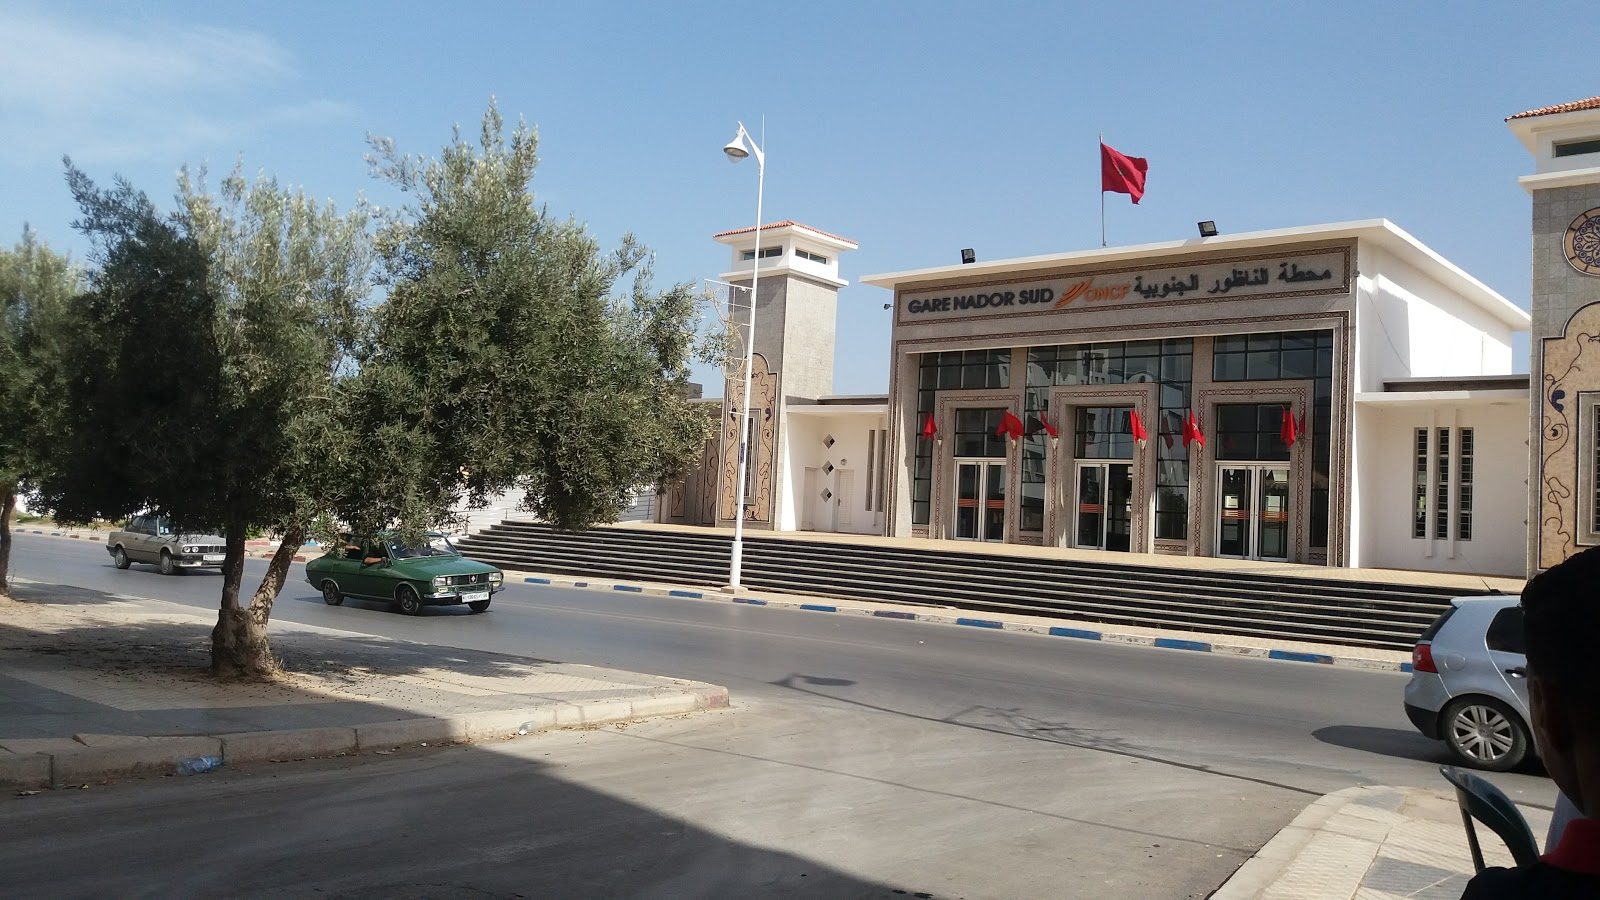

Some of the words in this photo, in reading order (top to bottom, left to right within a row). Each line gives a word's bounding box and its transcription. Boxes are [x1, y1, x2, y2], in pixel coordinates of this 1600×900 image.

[1207, 267, 1269, 294] الناظور
[1277, 262, 1332, 283] محطة
[1084, 283, 1130, 301] ONCF
[1133, 273, 1199, 299] الجنوبية
[908, 298, 951, 313] GARE
[953, 291, 1015, 311] NADOR
[1019, 288, 1054, 304] SUD
